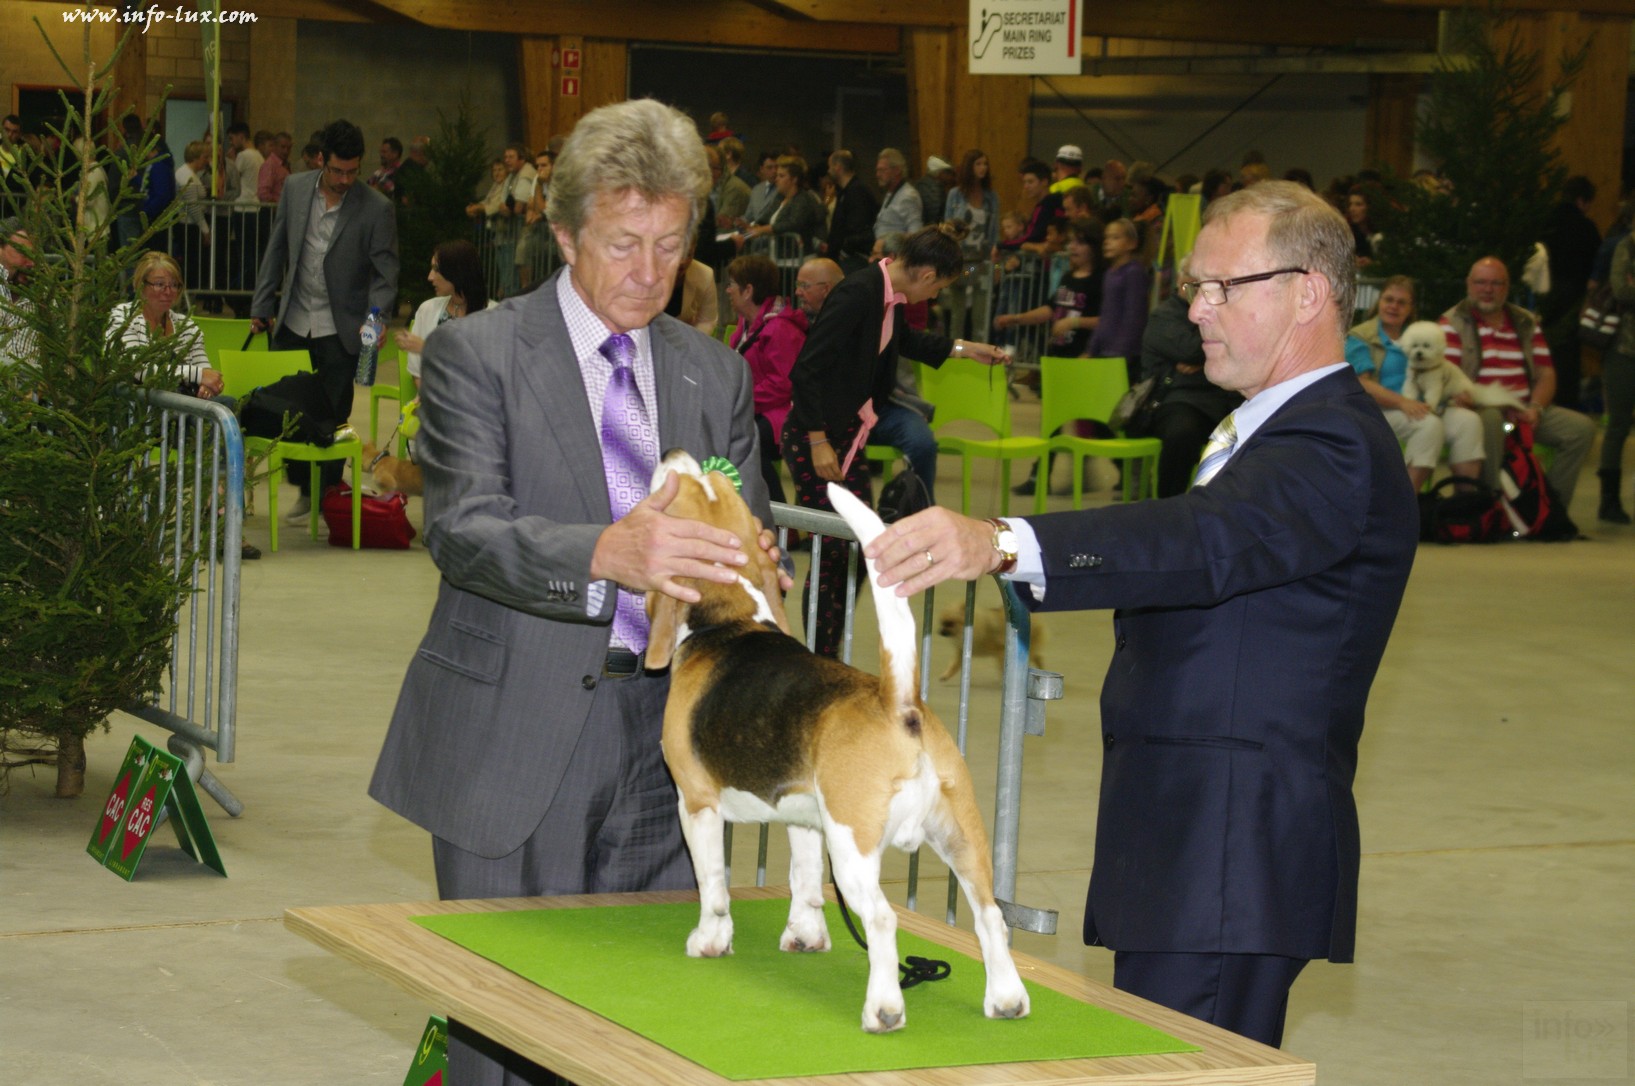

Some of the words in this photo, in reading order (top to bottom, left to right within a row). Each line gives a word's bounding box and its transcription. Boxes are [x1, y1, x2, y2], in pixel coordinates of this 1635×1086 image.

[1002, 11, 1066, 25] SECRETARIAT
[1003, 29, 1026, 43] MAIN
[1028, 29, 1052, 43] RING
[1003, 46, 1036, 60] PRIZES
[105, 793, 125, 822] CAC
[141, 797, 153, 812] RES
[127, 808, 150, 838] CAC
